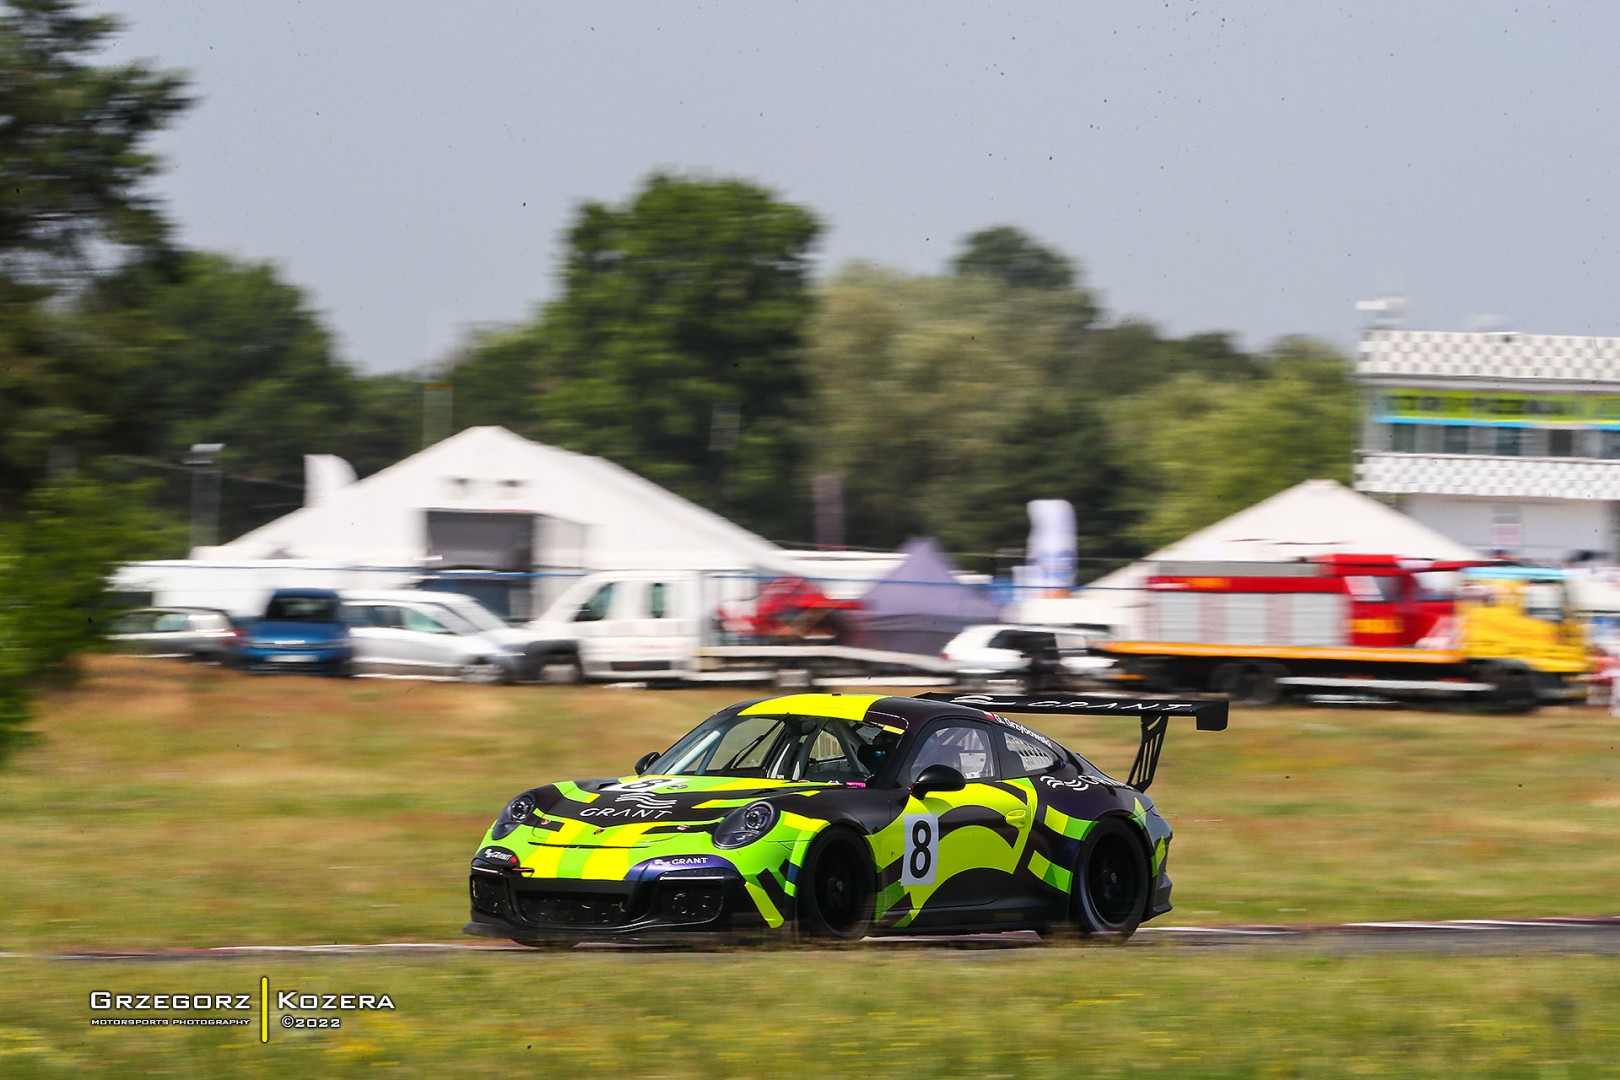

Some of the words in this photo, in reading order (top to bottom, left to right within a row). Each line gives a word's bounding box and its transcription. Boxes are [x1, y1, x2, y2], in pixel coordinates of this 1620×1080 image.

[1027, 700, 1192, 711] GRANT
[620, 778, 673, 790] 8
[579, 807, 673, 819] GRANT
[909, 820, 932, 879] 8
[671, 857, 709, 865] GRANT
